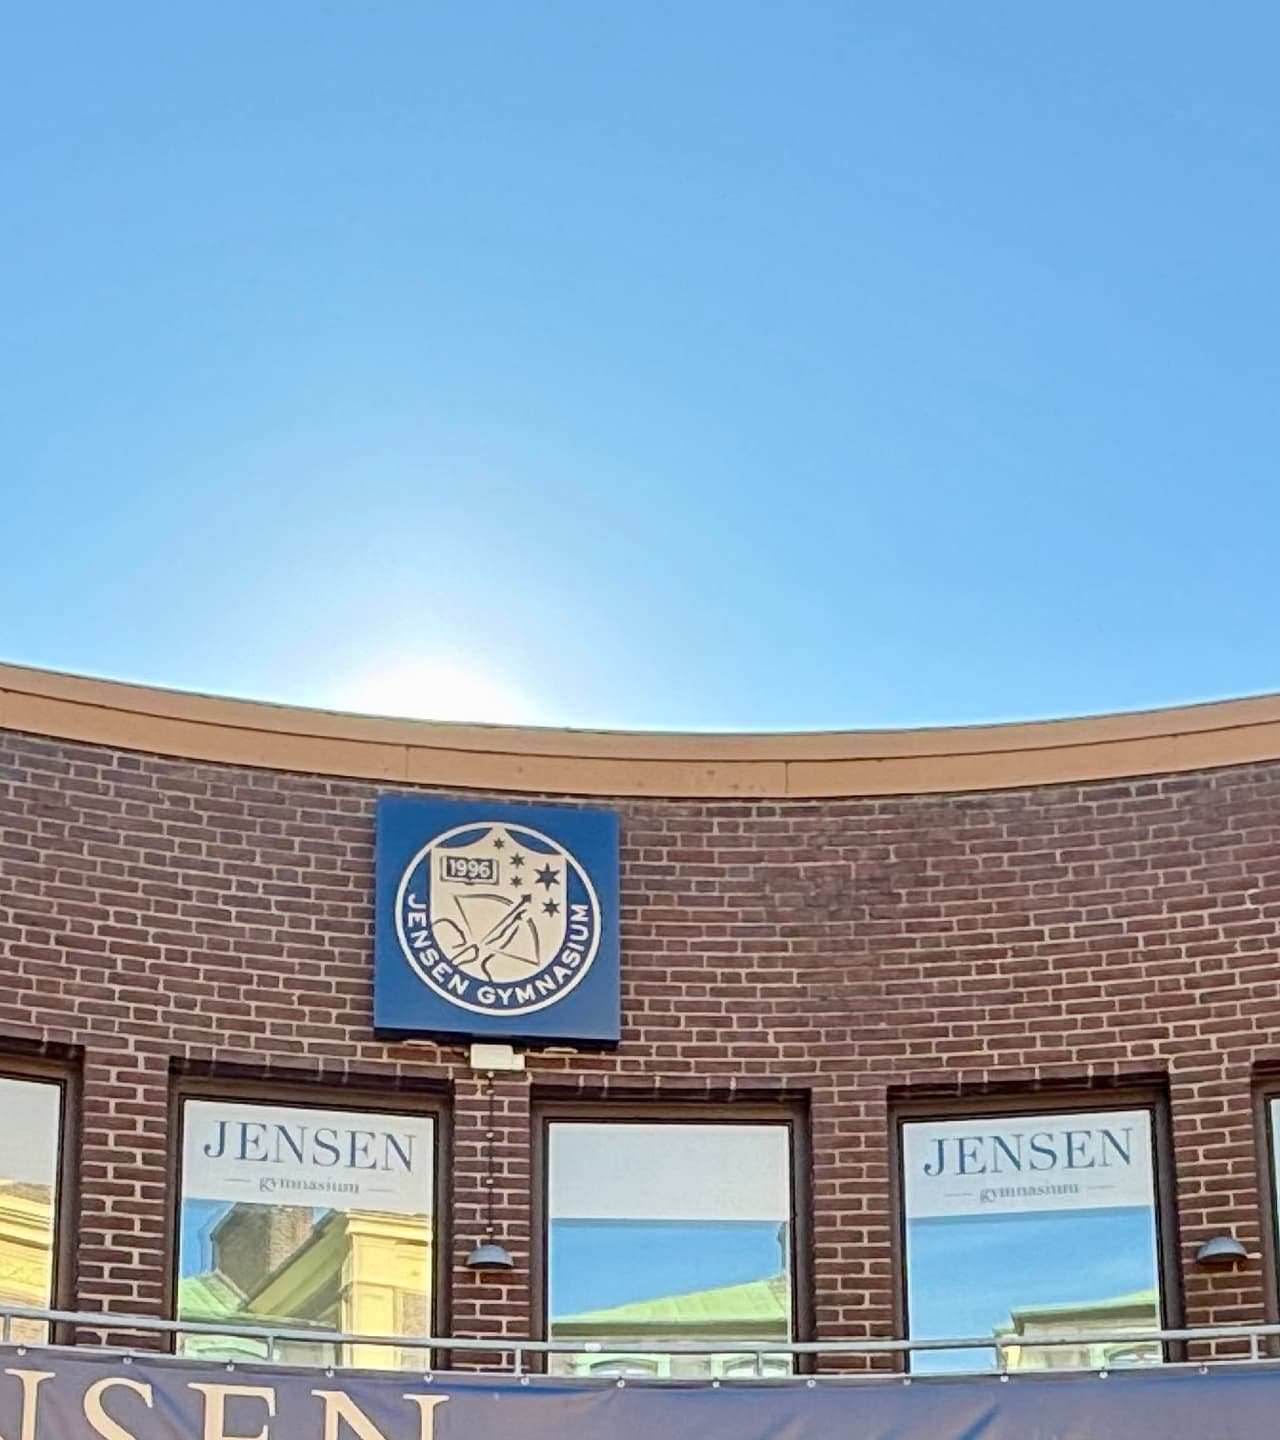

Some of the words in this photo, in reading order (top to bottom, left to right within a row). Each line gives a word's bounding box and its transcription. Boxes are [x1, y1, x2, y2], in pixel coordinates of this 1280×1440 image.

[448, 858, 492, 878] 1996
[407, 893, 470, 996] JENSEN
[476, 903, 589, 1006] GYMNASIUM
[203, 1119, 417, 1173] JENSEN
[923, 1127, 1134, 1177] JENSEN
[258, 1176, 360, 1195] gymnasium
[979, 1182, 1080, 1203] gymnasium
